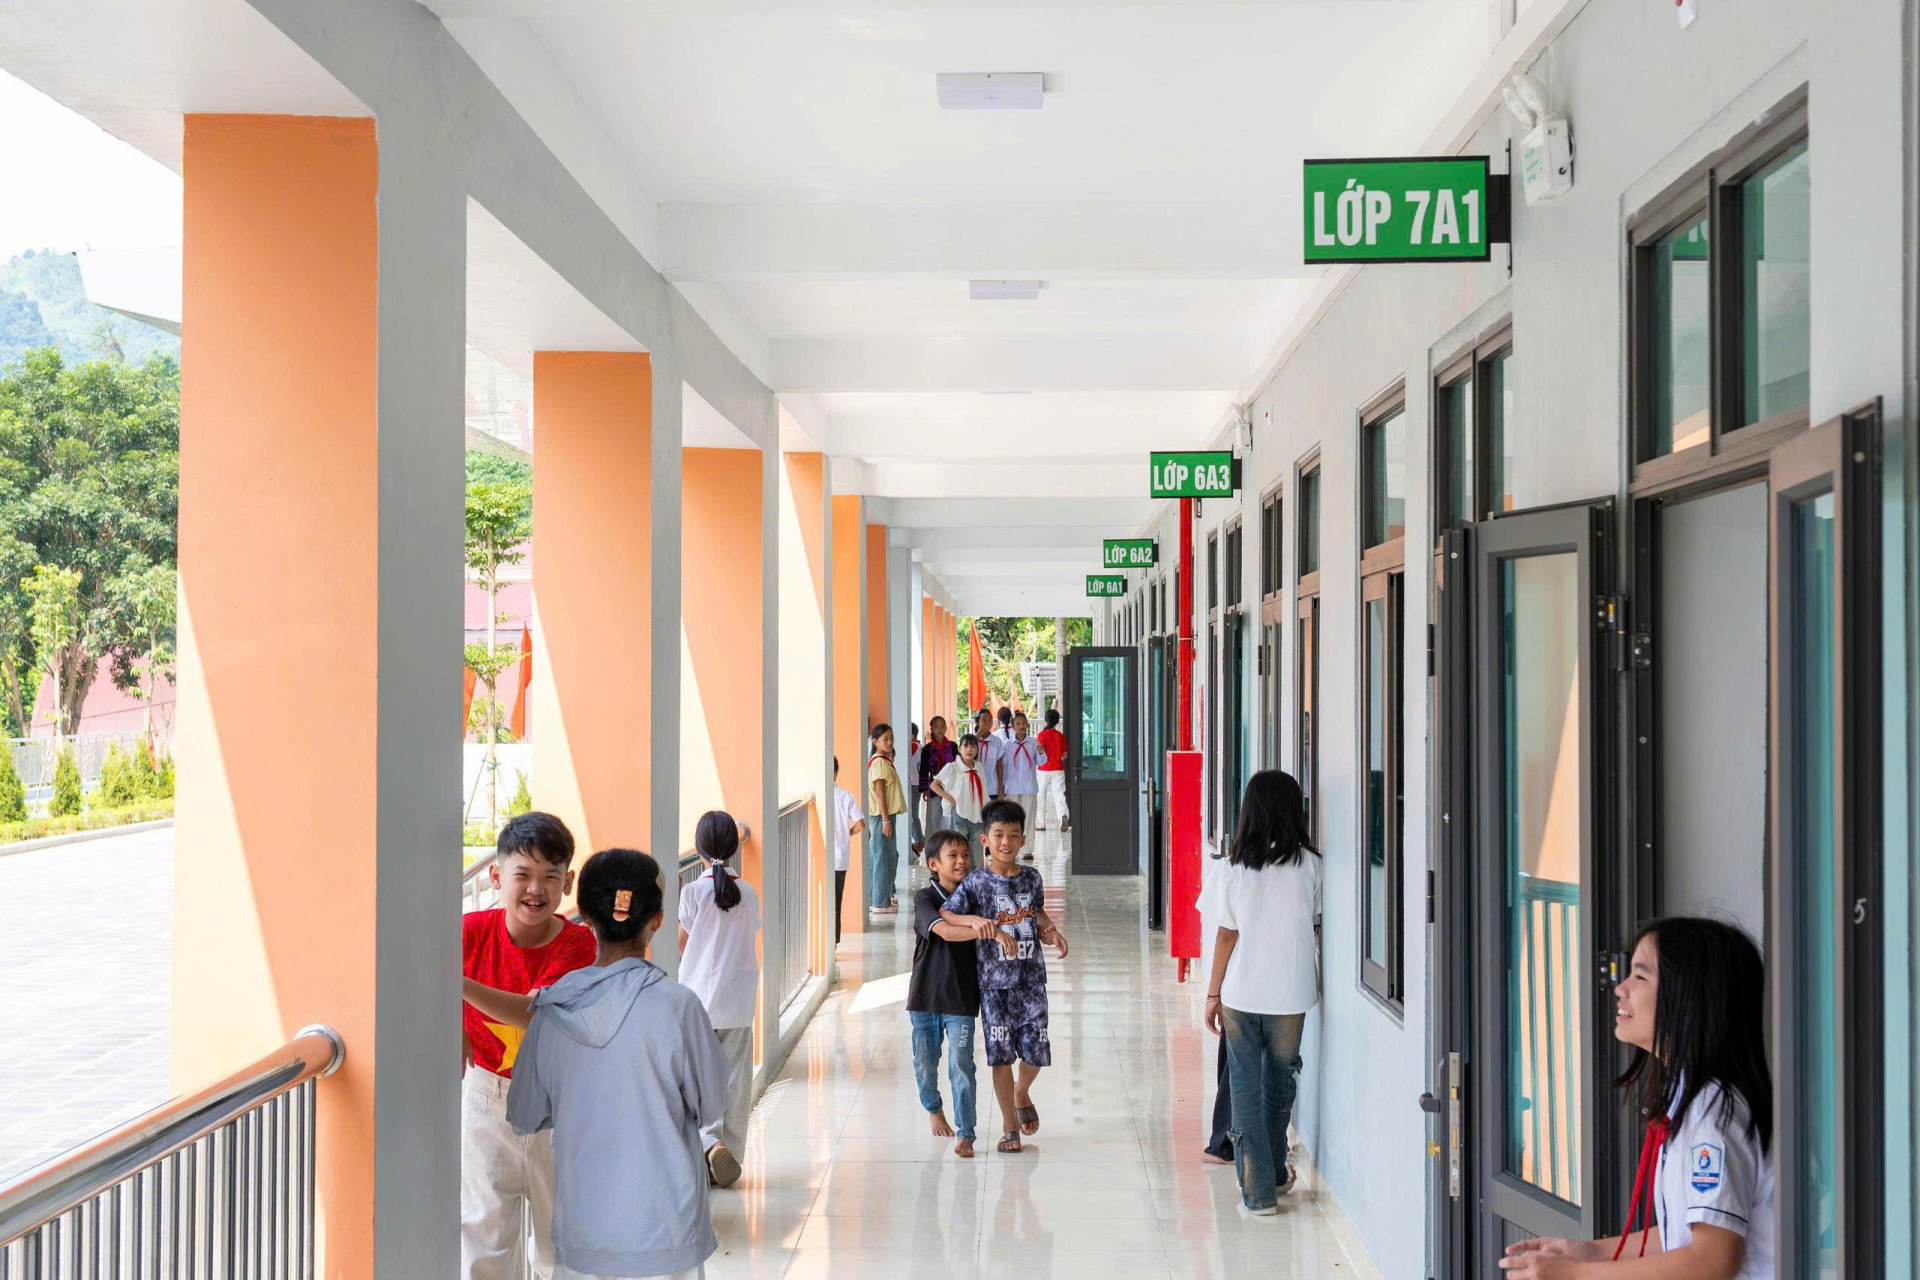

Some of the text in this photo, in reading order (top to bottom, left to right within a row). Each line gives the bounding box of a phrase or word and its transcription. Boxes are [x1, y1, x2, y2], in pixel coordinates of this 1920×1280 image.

[1313, 178, 1479, 247] LỚP 7A1
[1153, 459, 1230, 491] LỚP 6A3
[1105, 544, 1152, 564] LỚP 6A2
[1088, 579, 1122, 594] LỚP 6A1
[1854, 897, 1868, 924] 5
[998, 940, 1035, 962] 187
